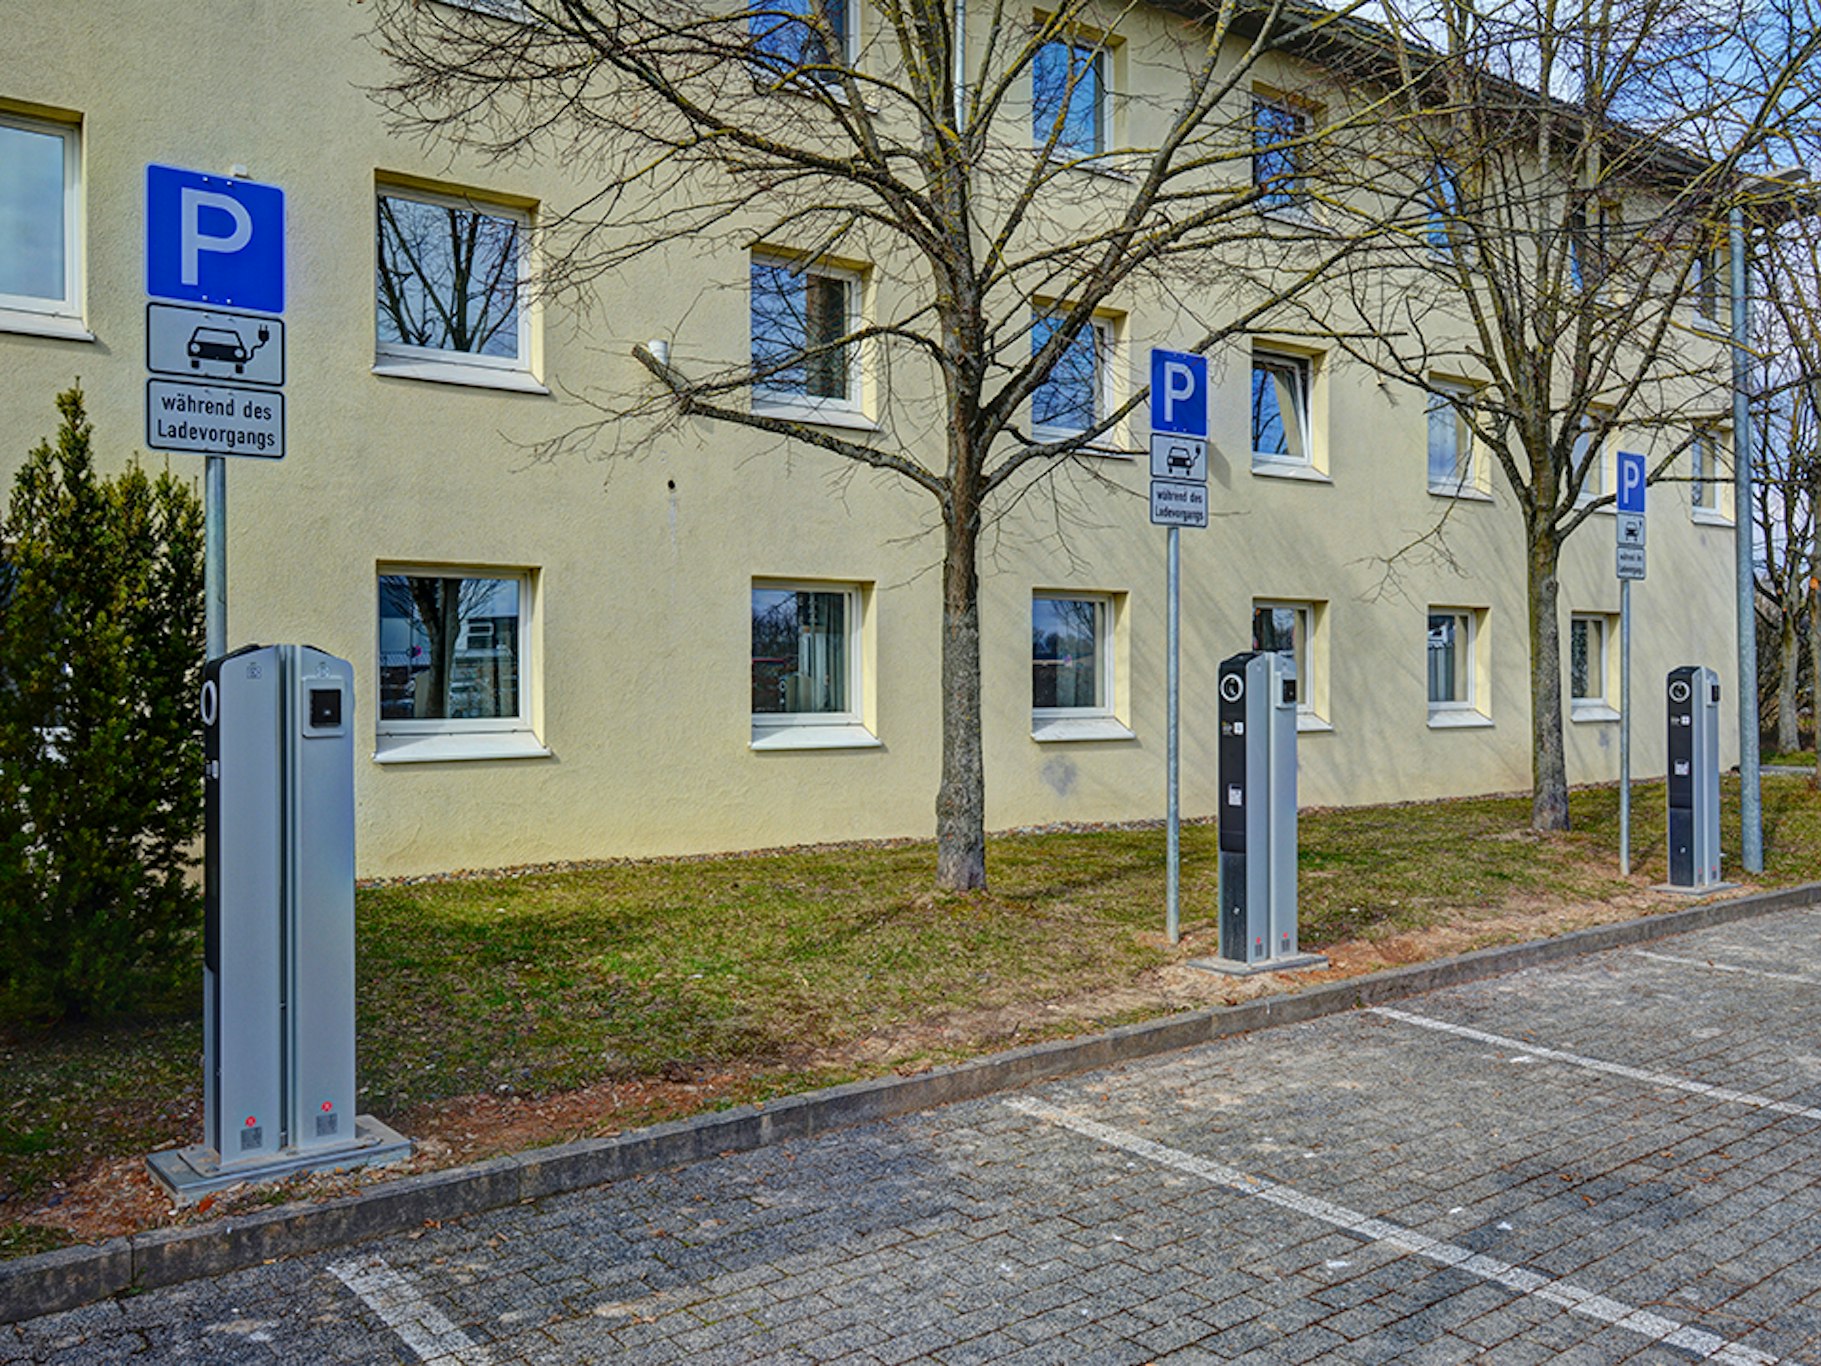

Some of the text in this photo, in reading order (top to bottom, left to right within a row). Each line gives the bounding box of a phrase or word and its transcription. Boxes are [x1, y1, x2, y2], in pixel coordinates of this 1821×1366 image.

[181, 187, 252, 286] P
[162, 394, 272, 420] während des
[1164, 361, 1195, 422] P
[158, 419, 275, 450] Ladevorgangs
[1190, 492, 1203, 504] des
[1623, 460, 1640, 504] P
